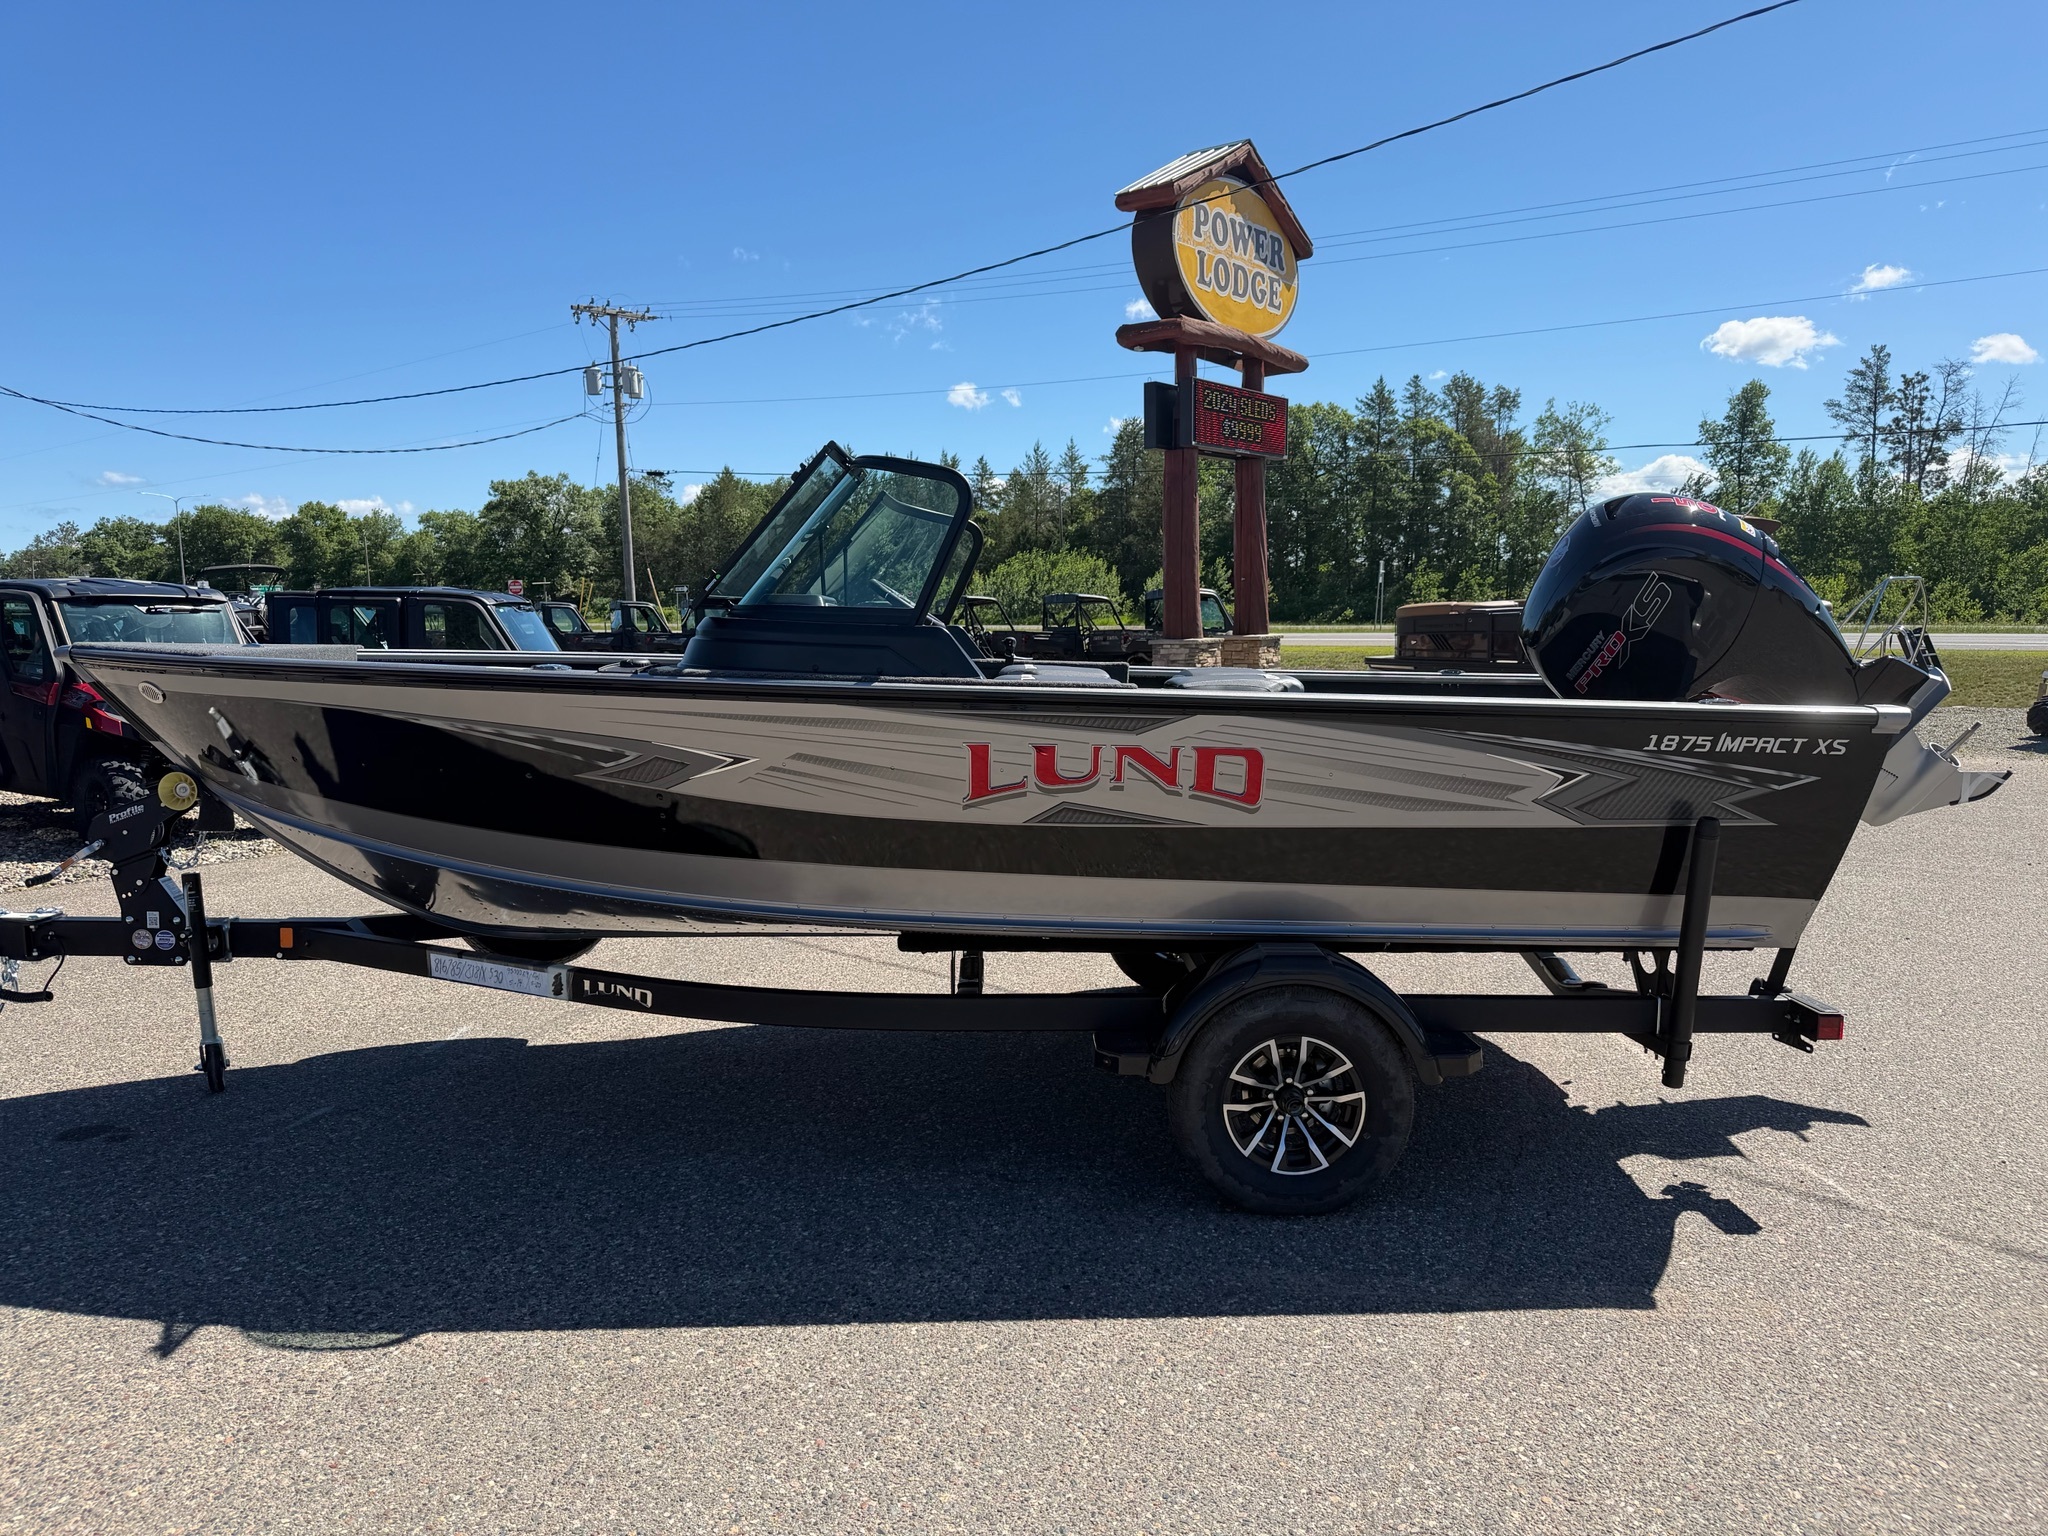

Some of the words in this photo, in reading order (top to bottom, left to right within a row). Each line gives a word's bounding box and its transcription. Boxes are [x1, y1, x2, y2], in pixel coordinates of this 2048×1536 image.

[1193, 200, 1286, 274] POWER
[1196, 248, 1283, 313] LODGE
[1203, 389, 1237, 414] 2024
[1240, 397, 1276, 421] SLEDS
[1565, 630, 1606, 680] MERCURY
[1643, 734, 1714, 751] 1875
[1715, 732, 1808, 754] IMPACT
[1812, 739, 1850, 755] XS
[962, 742, 1265, 808] LUND
[109, 804, 144, 822] Profile
[583, 979, 653, 1008] LUND
